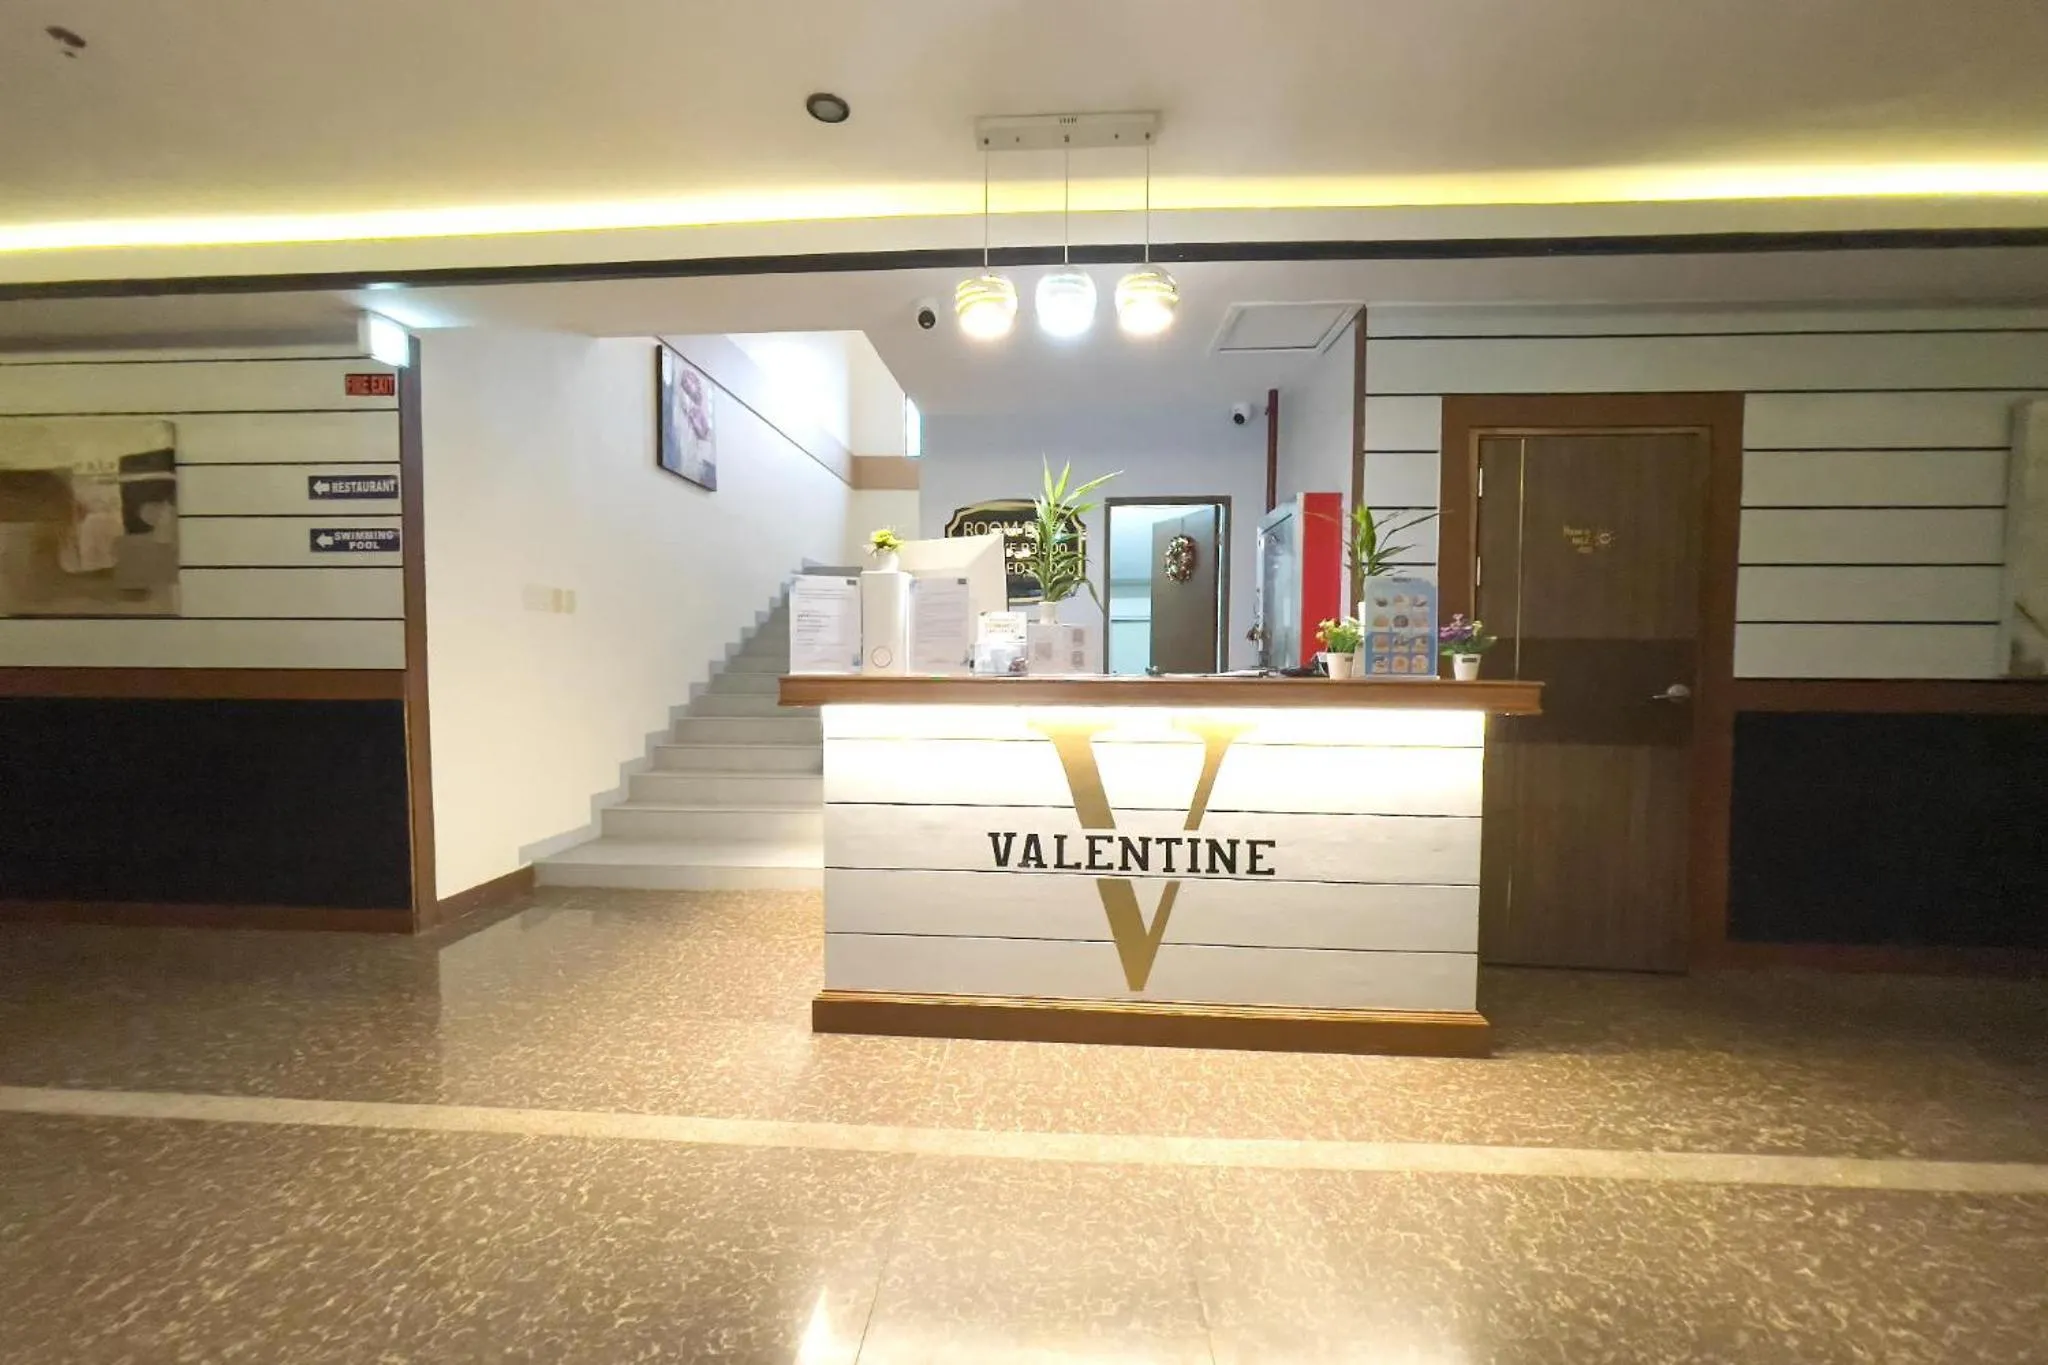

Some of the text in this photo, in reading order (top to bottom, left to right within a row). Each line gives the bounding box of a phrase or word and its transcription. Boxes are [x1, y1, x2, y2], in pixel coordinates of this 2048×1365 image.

[371, 376, 393, 394] EXIT
[332, 480, 395, 493] RESTAURANT
[334, 531, 394, 541] SWIMMING
[349, 541, 380, 550] POOL
[988, 832, 1276, 876] VALENTINE
